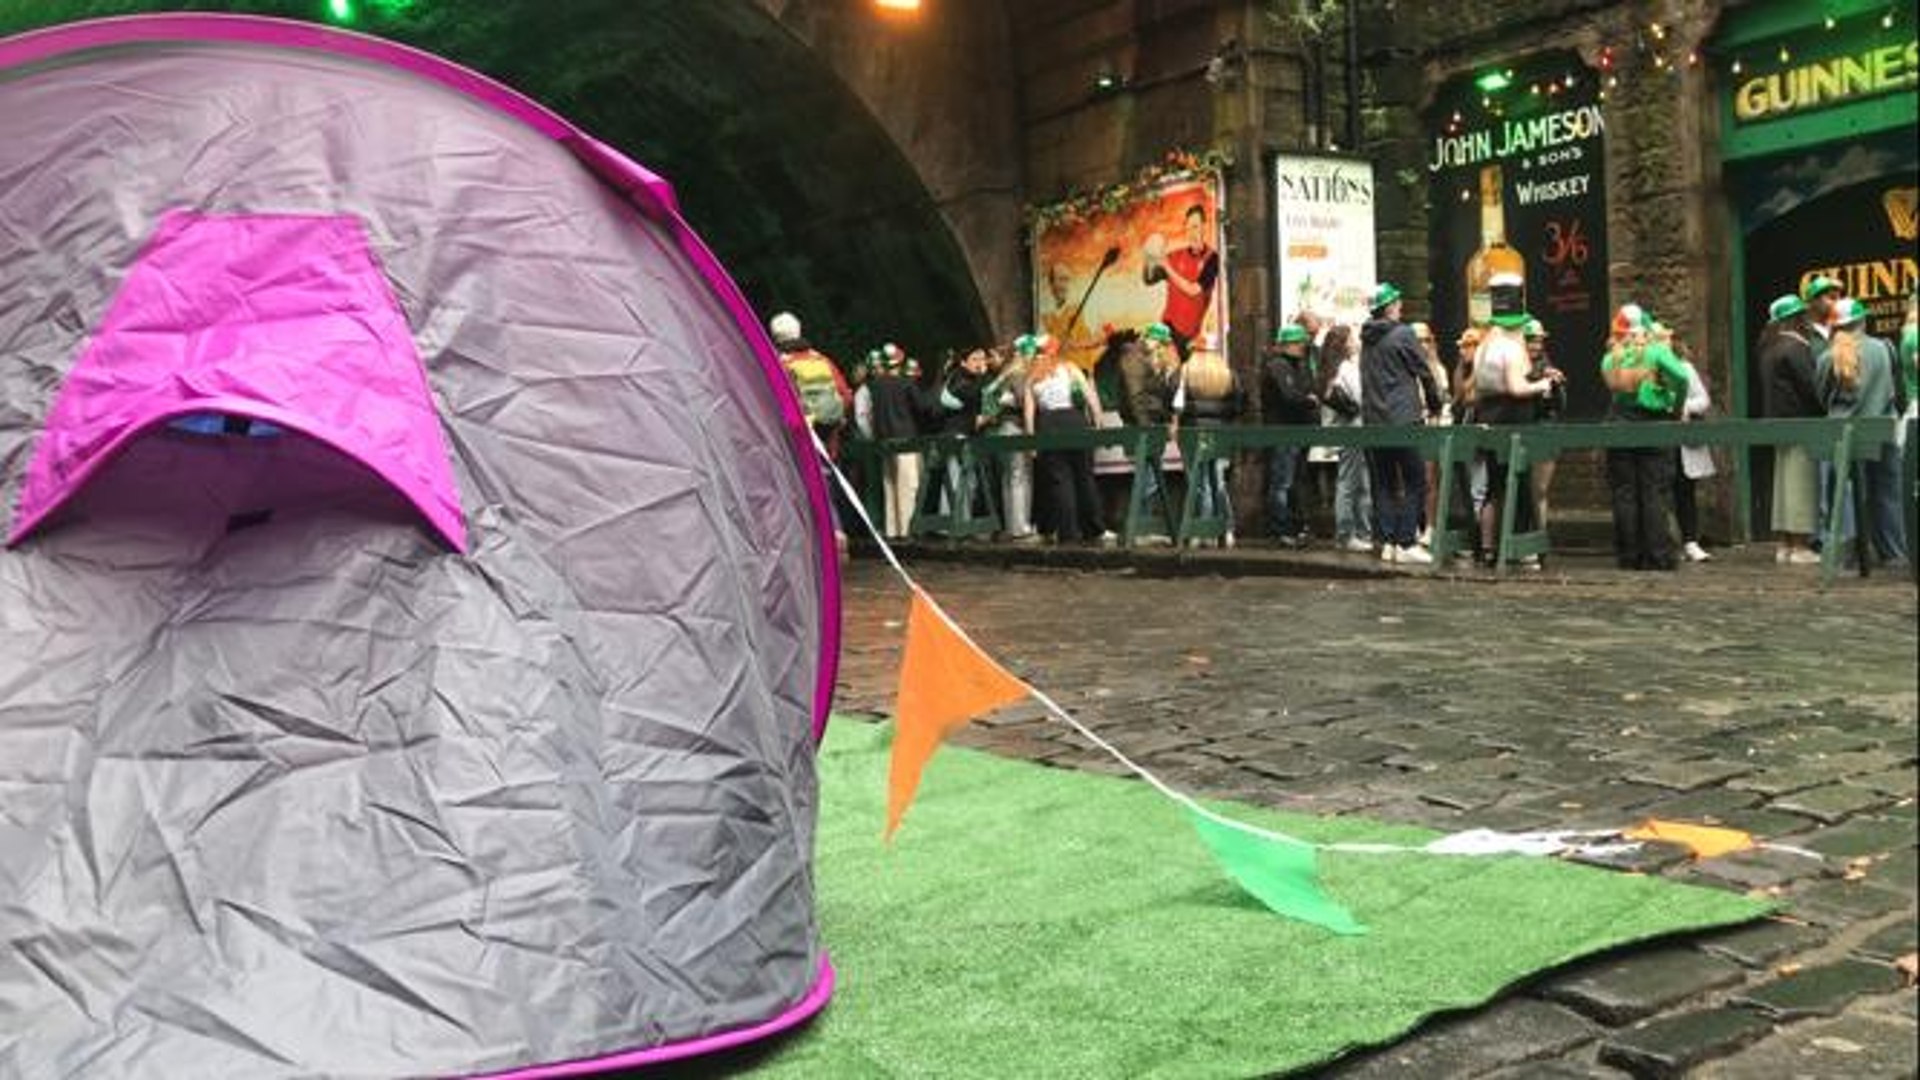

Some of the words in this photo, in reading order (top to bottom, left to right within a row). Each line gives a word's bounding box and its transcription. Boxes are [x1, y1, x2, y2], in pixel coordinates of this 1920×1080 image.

[1428, 130, 1492, 172] JOHN
[1495, 104, 1605, 156] JAMESON
[1516, 174, 1590, 205] WHISKEY
